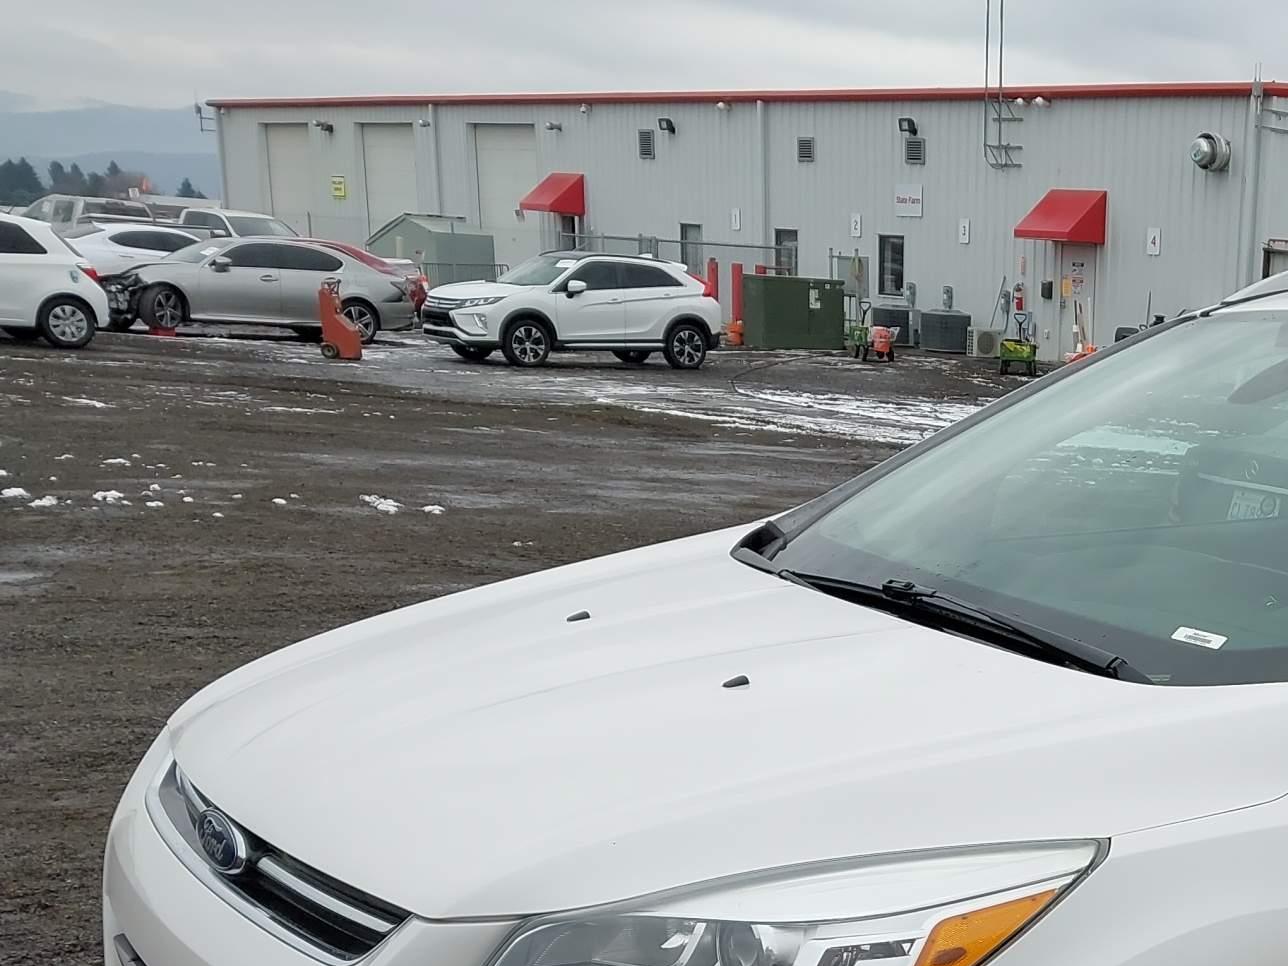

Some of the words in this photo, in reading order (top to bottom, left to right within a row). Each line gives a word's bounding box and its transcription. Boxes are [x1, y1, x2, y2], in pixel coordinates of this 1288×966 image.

[895, 195, 907, 204] State
[908, 196, 921, 205] Farm
[853, 219, 858, 231] 2
[962, 225, 967, 236] 3
[1150, 235, 1157, 248] 4
[201, 816, 228, 861] Ford
